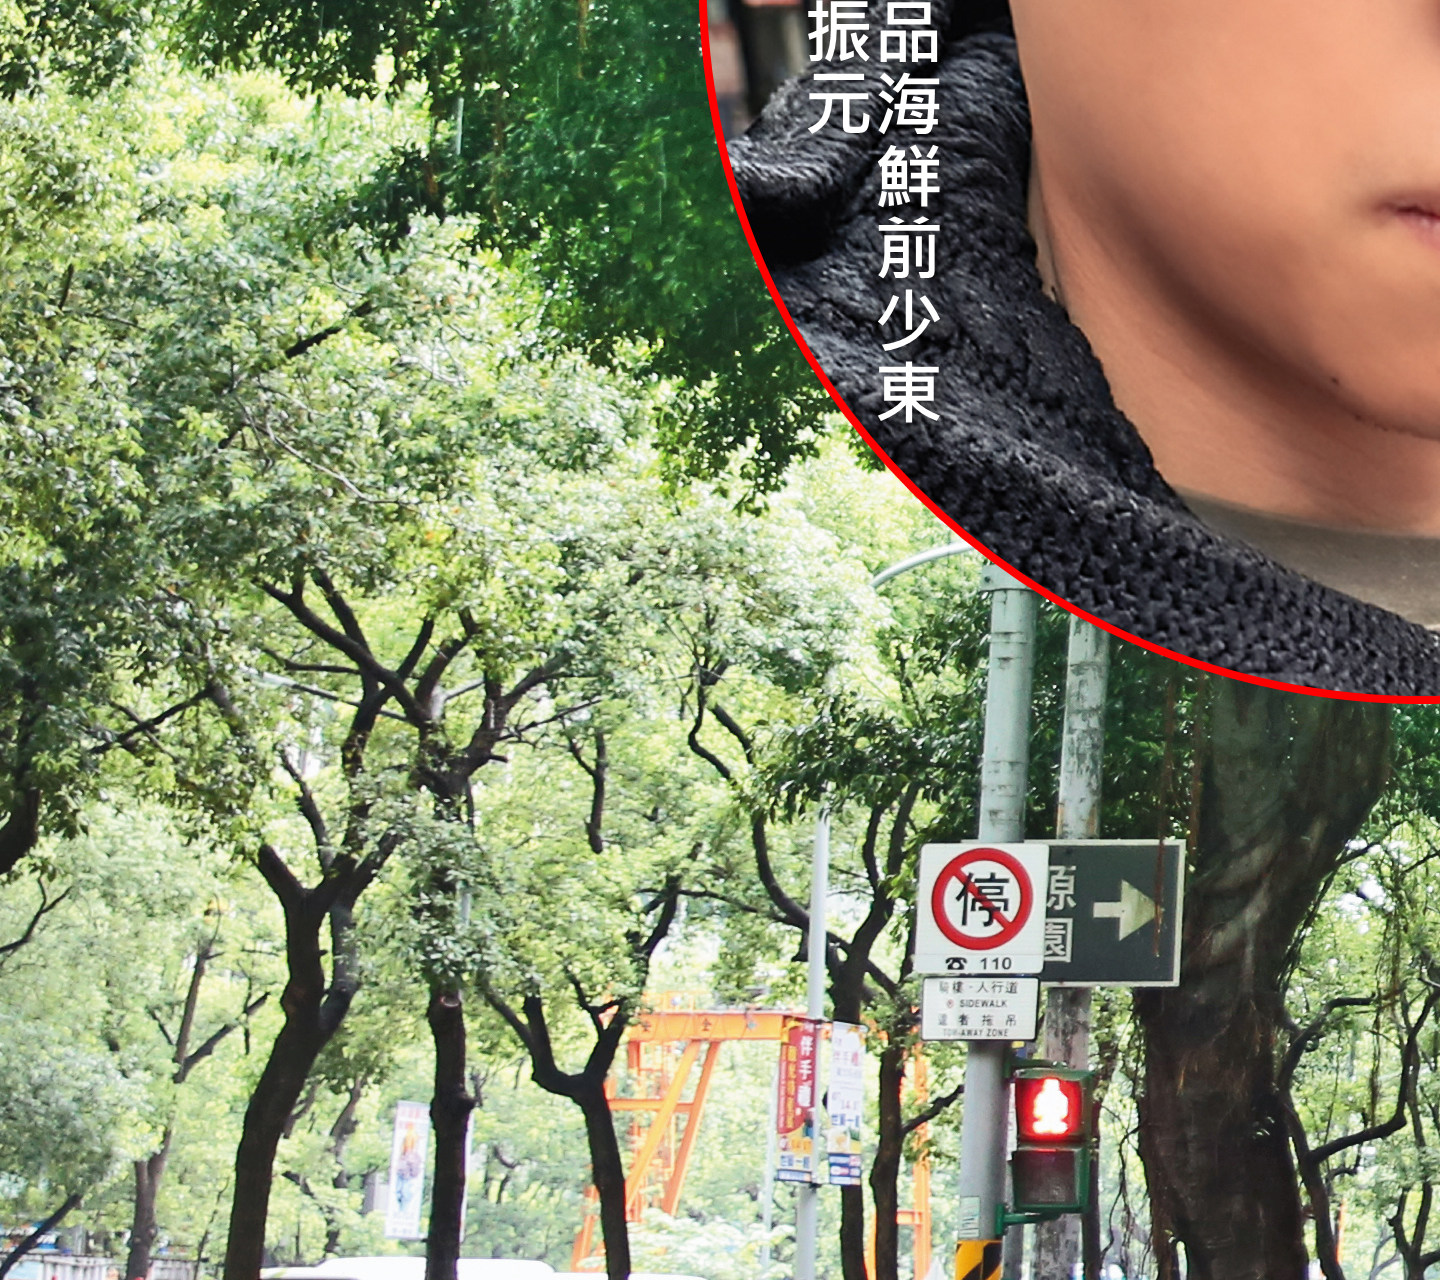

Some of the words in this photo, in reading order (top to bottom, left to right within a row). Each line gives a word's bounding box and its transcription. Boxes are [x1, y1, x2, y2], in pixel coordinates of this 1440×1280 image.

[955, 871, 1010, 928] 停
[980, 956, 1012, 971] 110
[959, 1000, 1008, 1008] SIDEWALK
[986, 1029, 1009, 1037] ZONE
